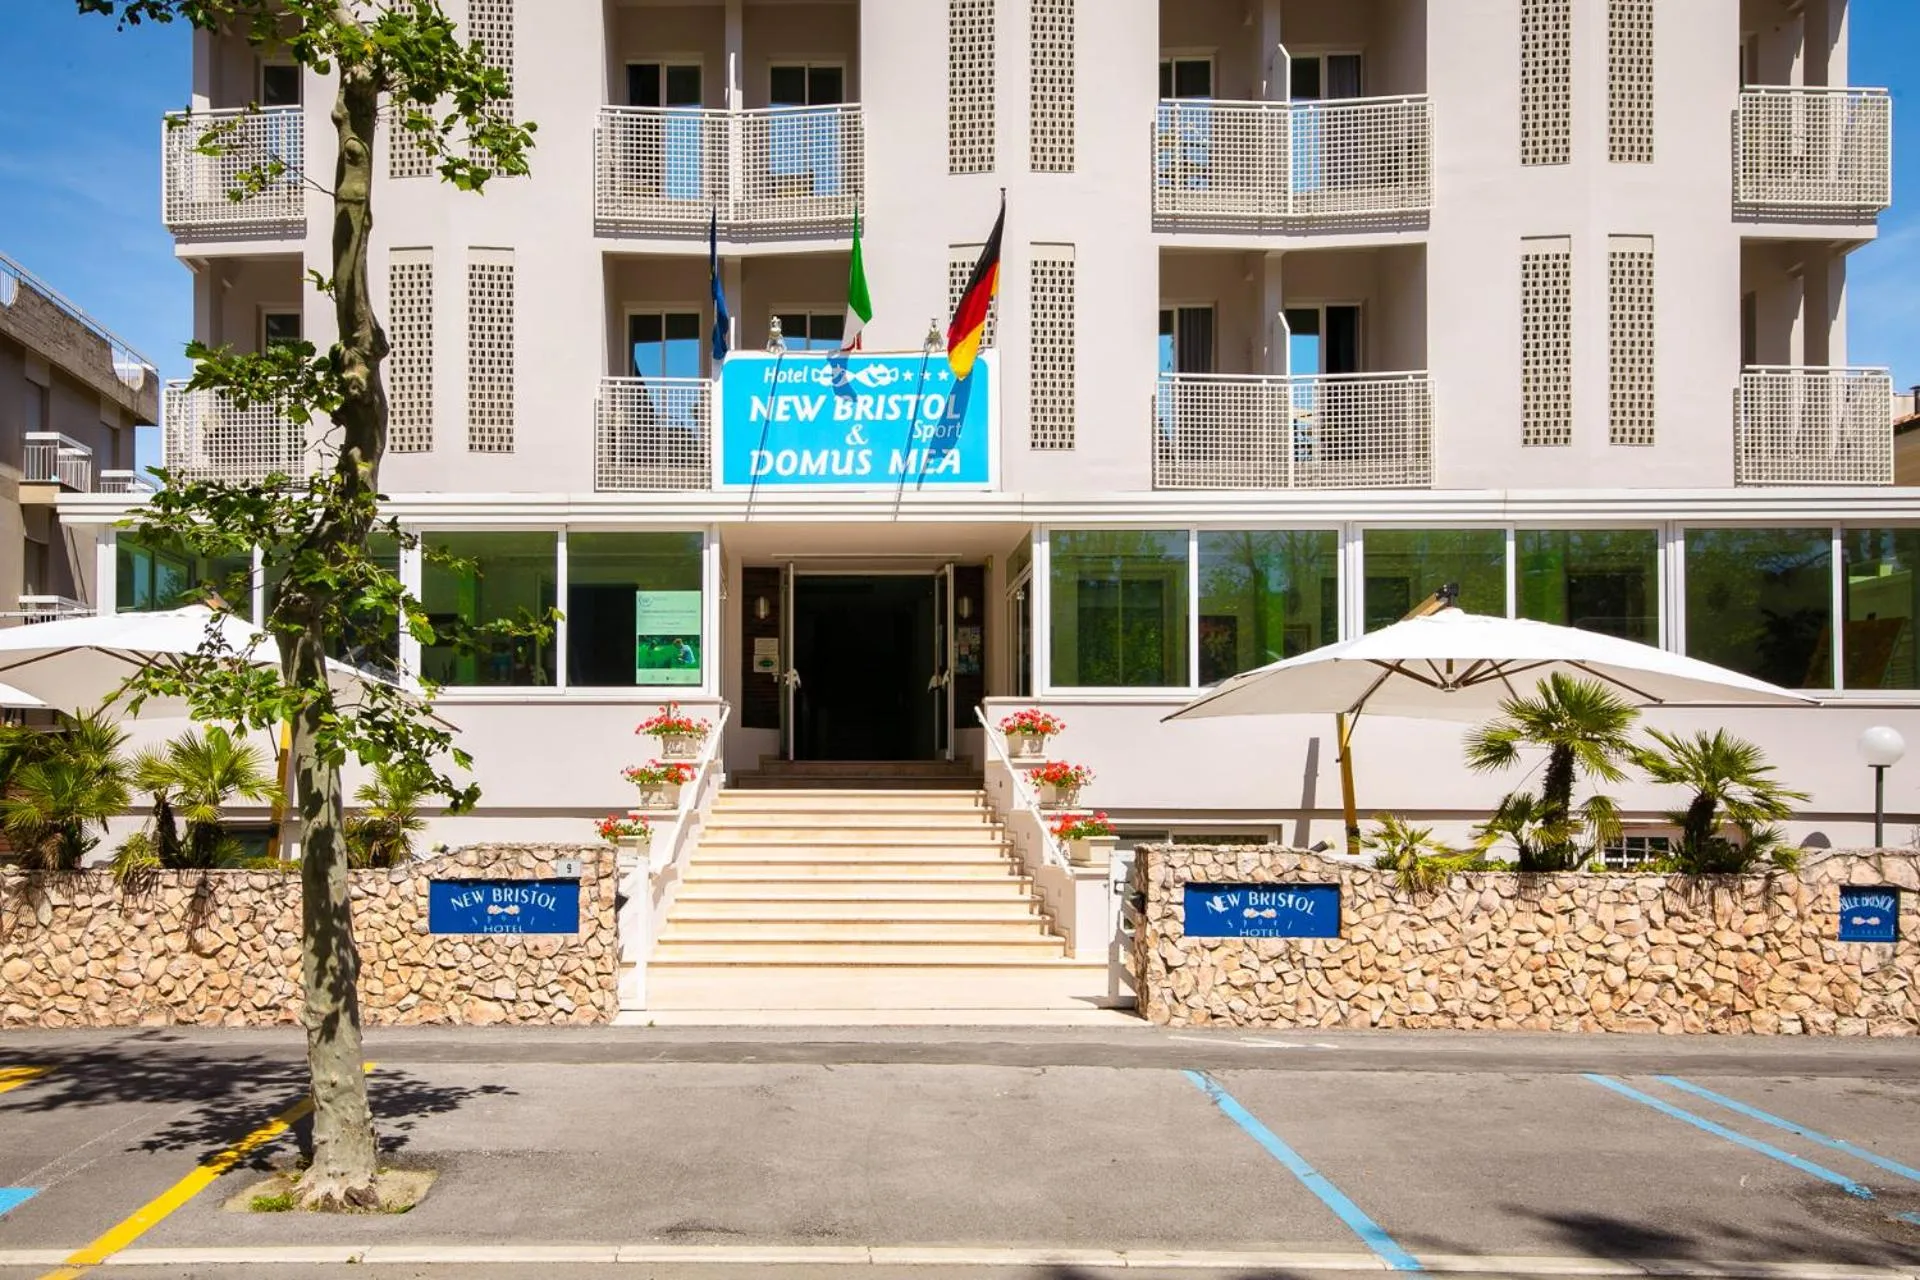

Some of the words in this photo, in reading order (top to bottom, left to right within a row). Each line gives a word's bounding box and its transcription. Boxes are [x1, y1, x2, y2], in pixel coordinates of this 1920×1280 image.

[764, 366, 808, 384] Hotel
[749, 394, 826, 422] NEW
[833, 393, 961, 421] BRISTOL
[845, 423, 869, 446] &
[912, 419, 962, 442] Sport
[750, 449, 872, 476] DOMUS
[888, 448, 961, 475] MEA
[451, 889, 485, 912] NEW
[492, 887, 557, 912] BRISTOL
[1205, 893, 1241, 915] NEW
[1248, 891, 1316, 917] BRISTOL
[483, 925, 525, 933] HOTEL
[1239, 928, 1281, 938] HOTEL
